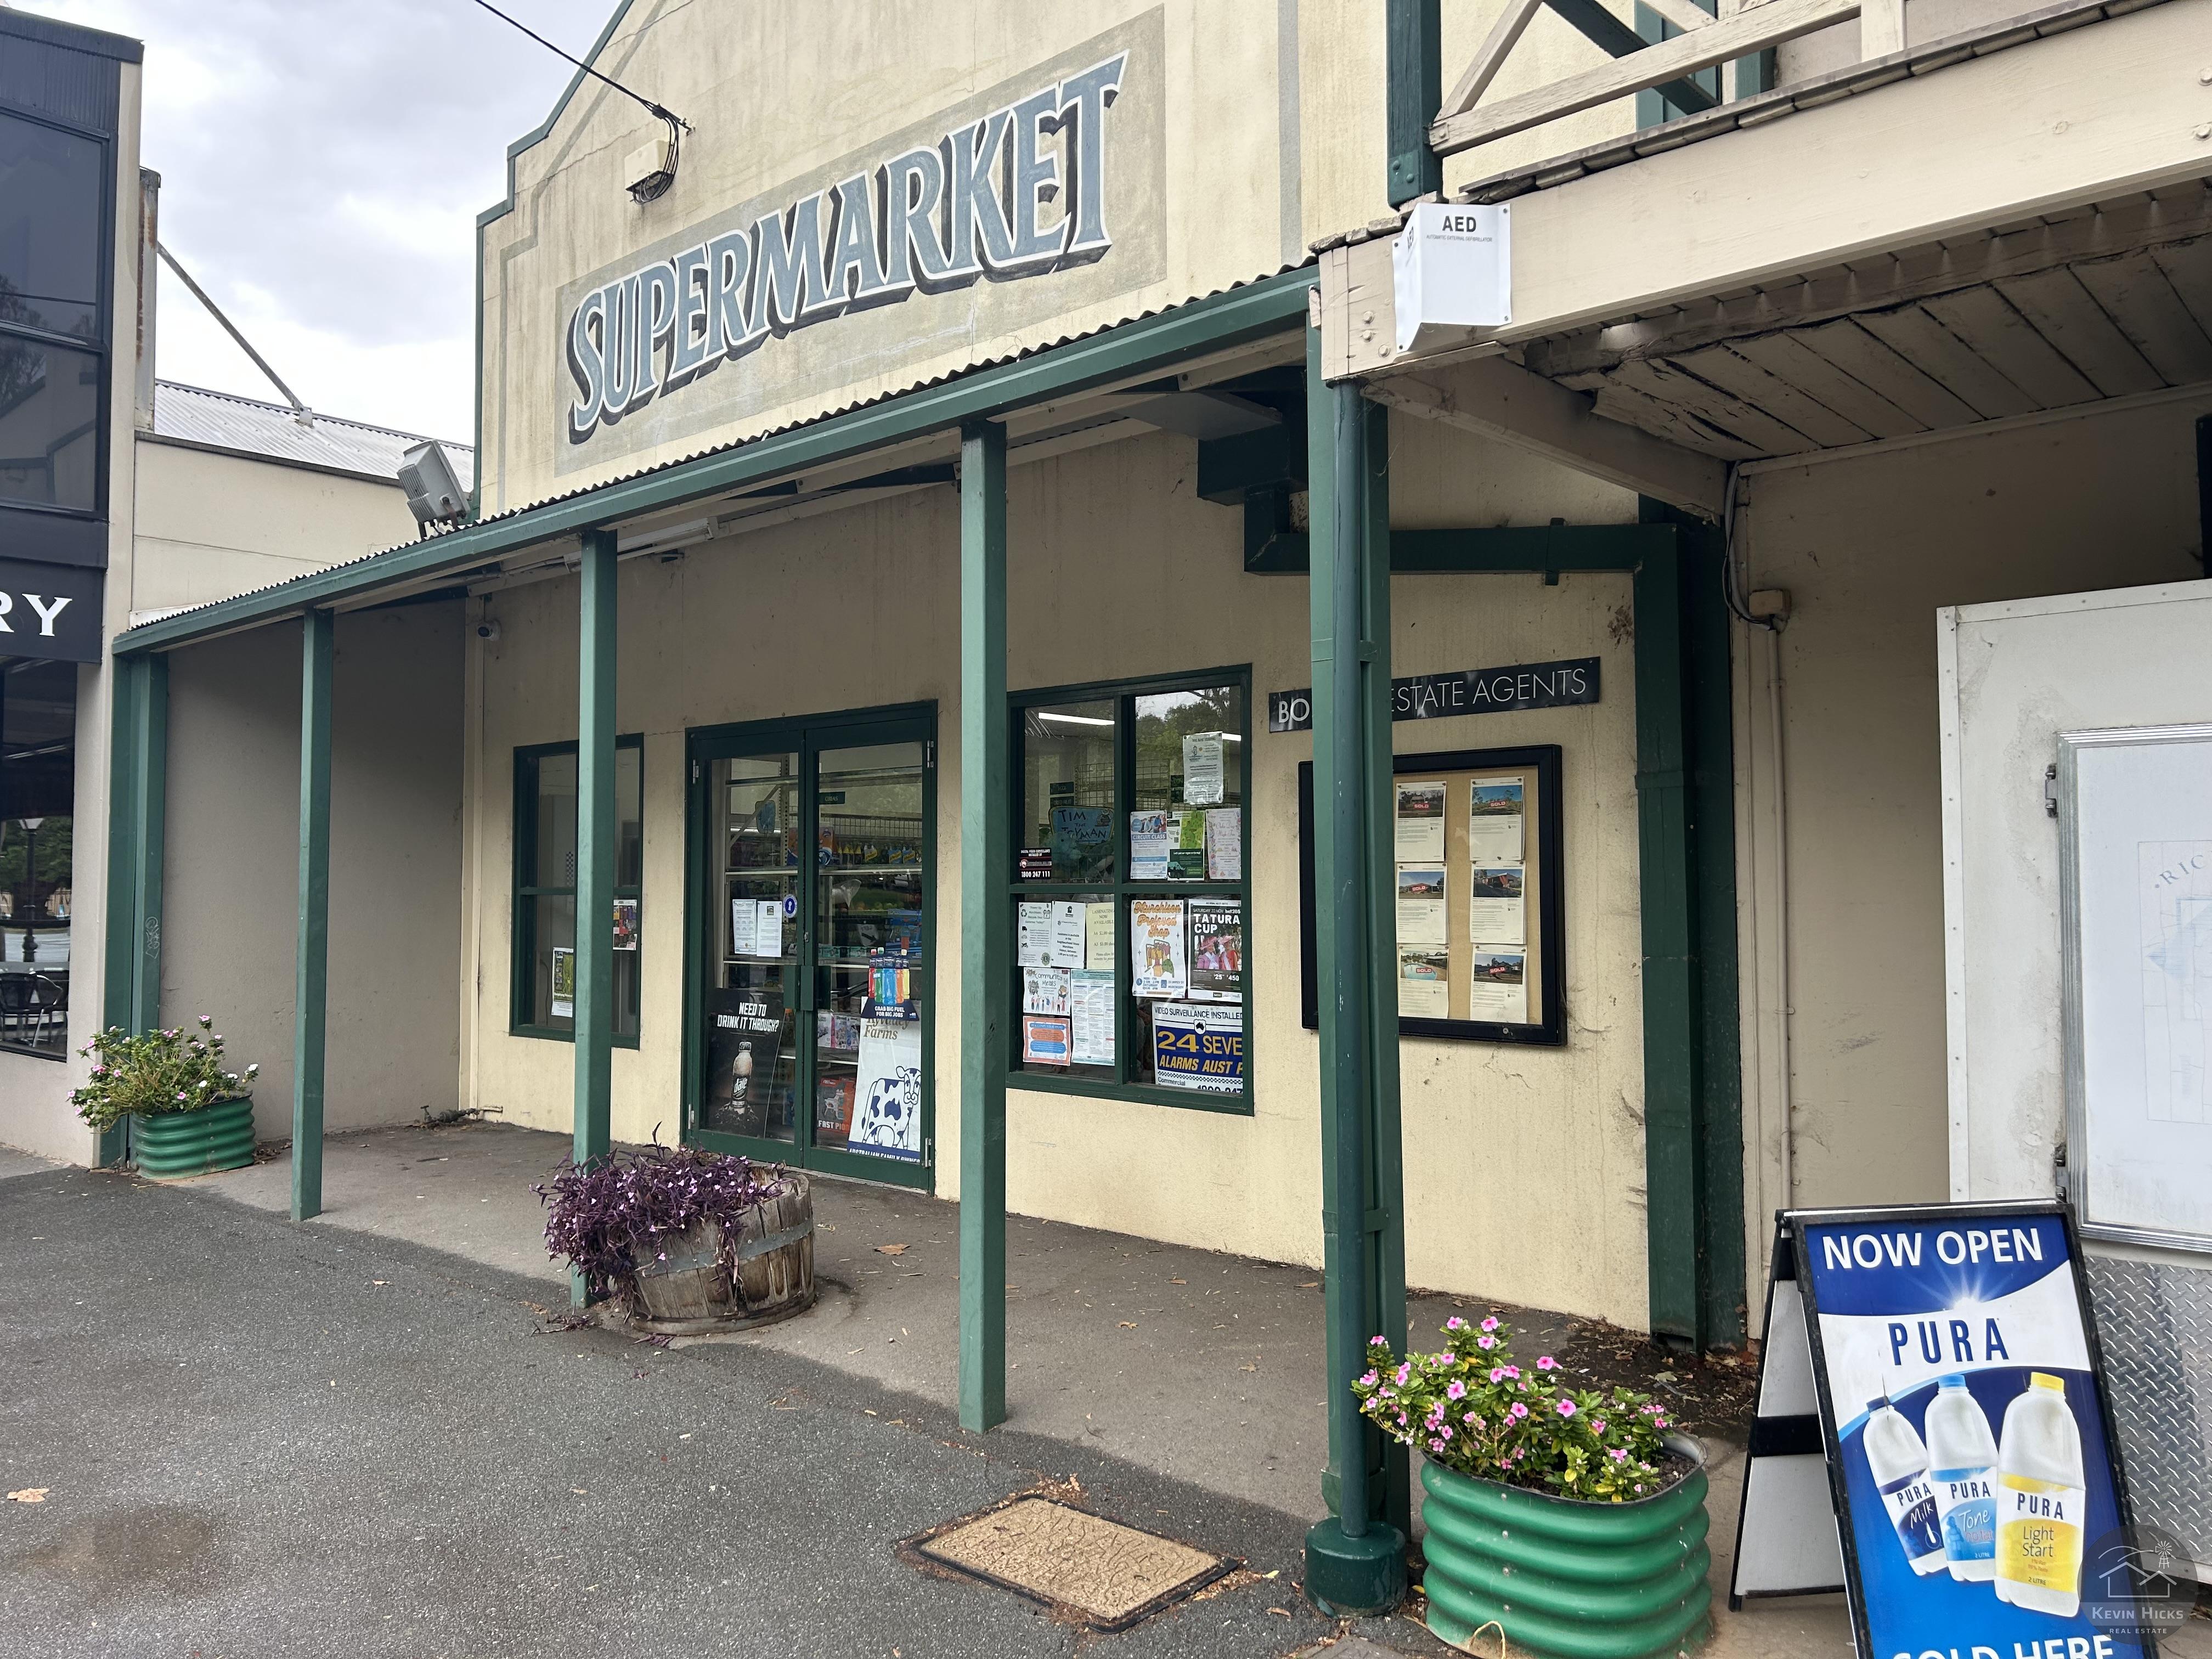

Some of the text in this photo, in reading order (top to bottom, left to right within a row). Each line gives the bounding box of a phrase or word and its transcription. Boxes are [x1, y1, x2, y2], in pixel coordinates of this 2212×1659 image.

[1442, 216, 1476, 232] AED
[567, 49, 1130, 442] SUPERMARKET
[1278, 668, 1587, 723] BO STATE AGENTS
[1058, 809, 1086, 822] TIM
[2159, 855, 2212, 884] RIC
[1193, 913, 1240, 925] TATURA
[1148, 924, 1170, 940] Shop
[1194, 924, 1218, 934] CUP
[739, 1002, 767, 1017] NEED TO
[1154, 1006, 1242, 1020] VIDEO SURVEILLANCE INSTALLED
[717, 1015, 780, 1032] DRINK IT THROUGH?
[864, 1025, 898, 1040] Farms
[1158, 1031, 1243, 1056] 24 SEVE
[1159, 1054, 1243, 1075] ALARMS AUST P
[1158, 1076, 1186, 1086] Commercial
[818, 1120, 834, 1130] FAST
[1822, 1227, 2043, 1271] NOW OPEN
[1887, 1317, 2009, 1366] PURA
[1897, 1482, 1932, 1506] PURA
[1950, 1481, 1991, 1499] PURA
[2017, 1492, 2064, 1520] PURA
[1910, 1501, 1935, 1530] Milk
[1959, 1509, 1991, 1532] Tone
[2023, 1526, 2055, 1545] Light
[2022, 1542, 2054, 1558] Start
